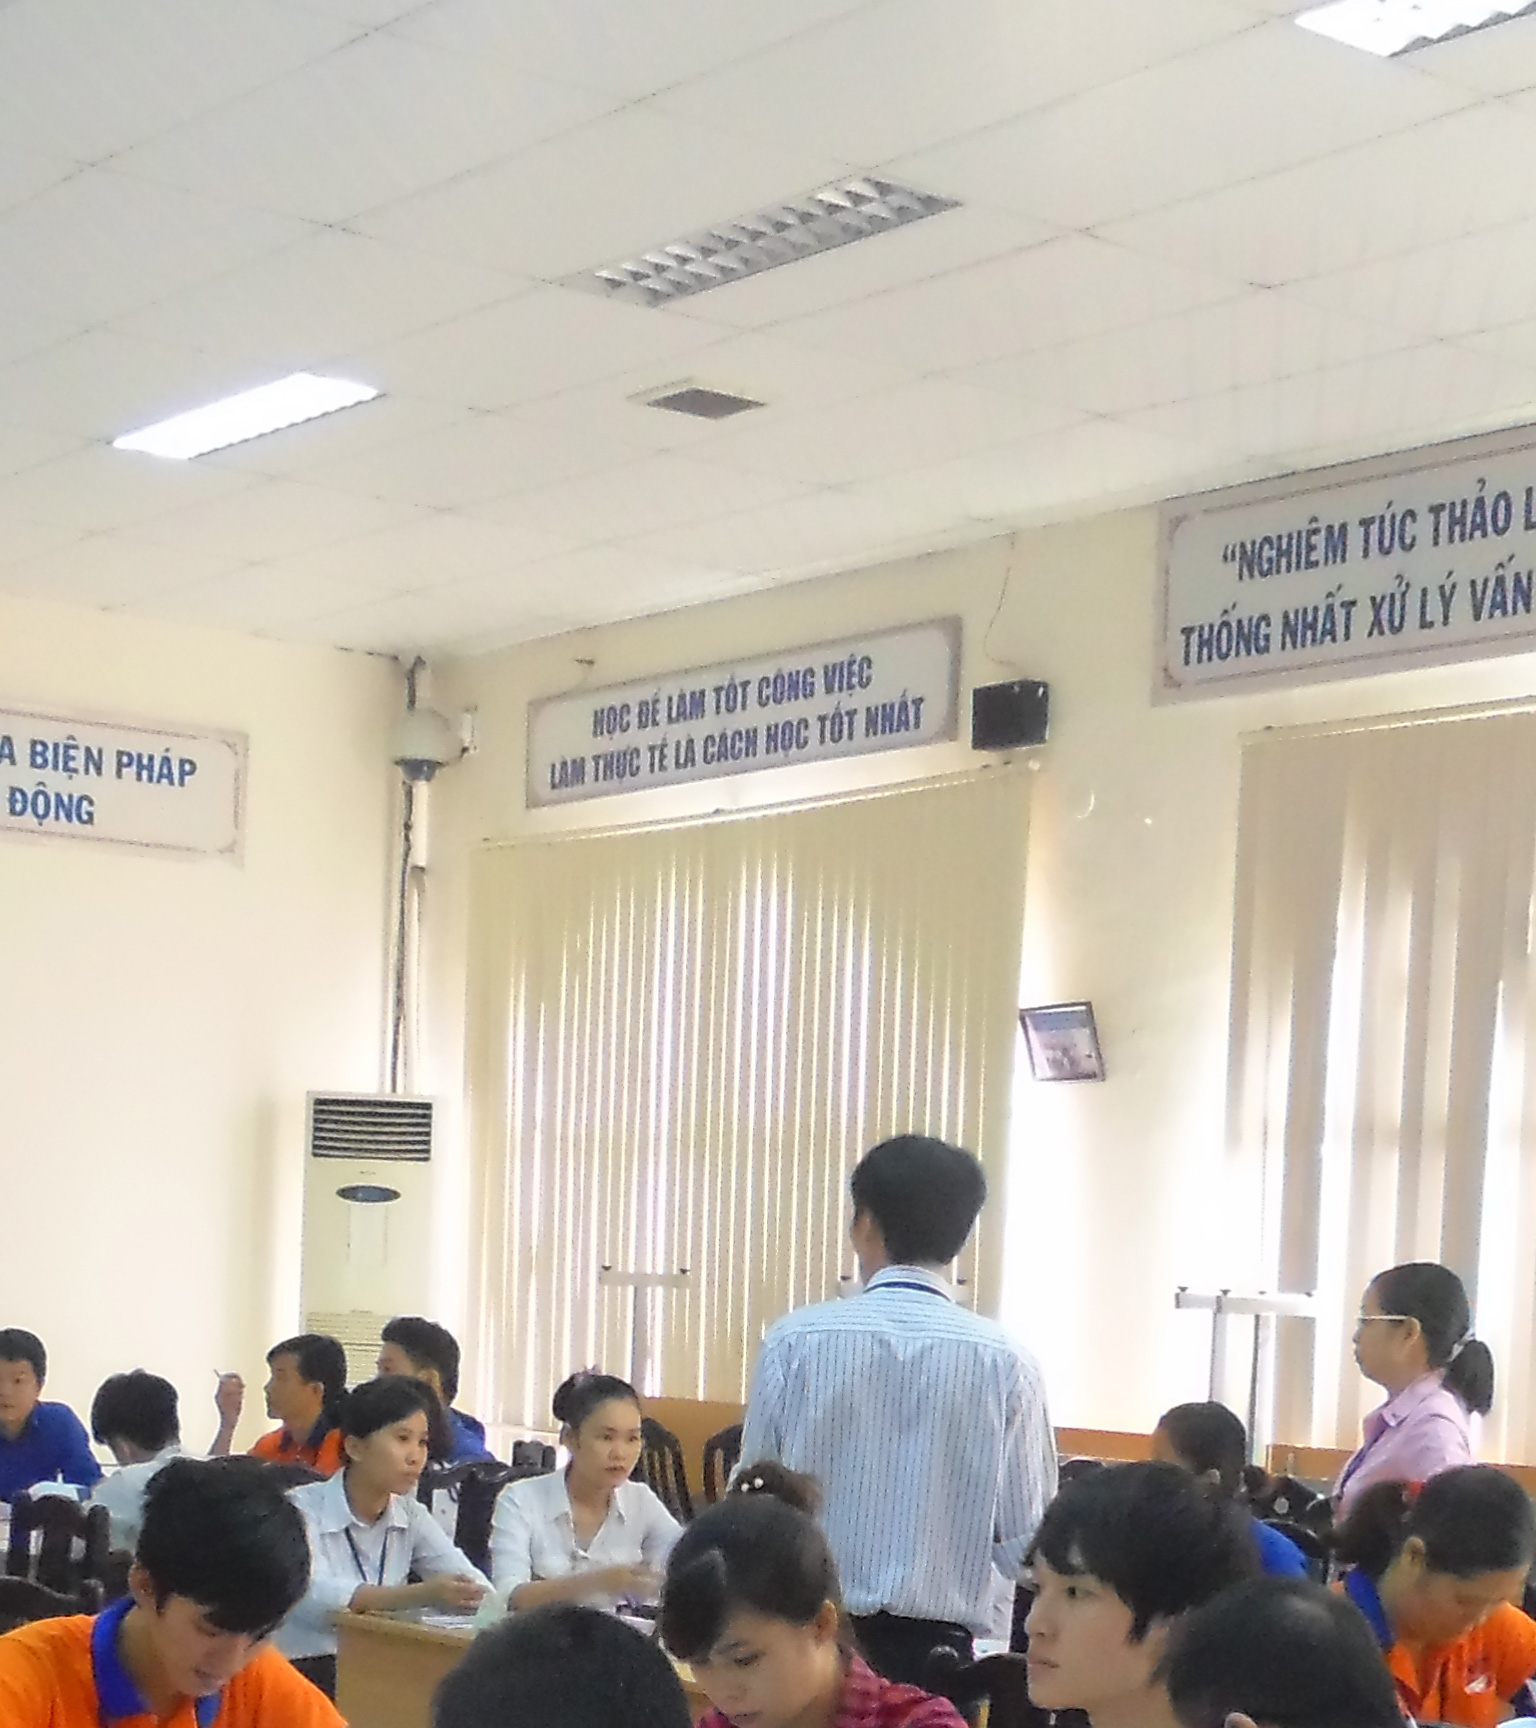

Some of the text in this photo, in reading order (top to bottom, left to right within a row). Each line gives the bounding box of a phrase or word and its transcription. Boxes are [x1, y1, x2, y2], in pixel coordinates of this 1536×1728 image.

[1360, 501, 1418, 560] TÚC
[1429, 478, 1512, 548] THẢO
[1180, 602, 1272, 666] THỐNG
[1281, 583, 1359, 652] NHẤT
[1367, 574, 1411, 638] XỬ
[1419, 569, 1459, 630] LÝ
[1470, 555, 1534, 622] VẤN
[591, 703, 631, 741] HỌC
[757, 668, 816, 708] CÔNG
[822, 653, 873, 698] VIỆC
[703, 726, 758, 766] CÁCH
[766, 717, 810, 758] HỌC
[816, 701, 858, 745] TỐT
[864, 688, 925, 738] NHẤT
[29, 734, 103, 780] BIỆN
[115, 747, 198, 788] PHÁP
[8, 781, 96, 826] ĐỘNG
